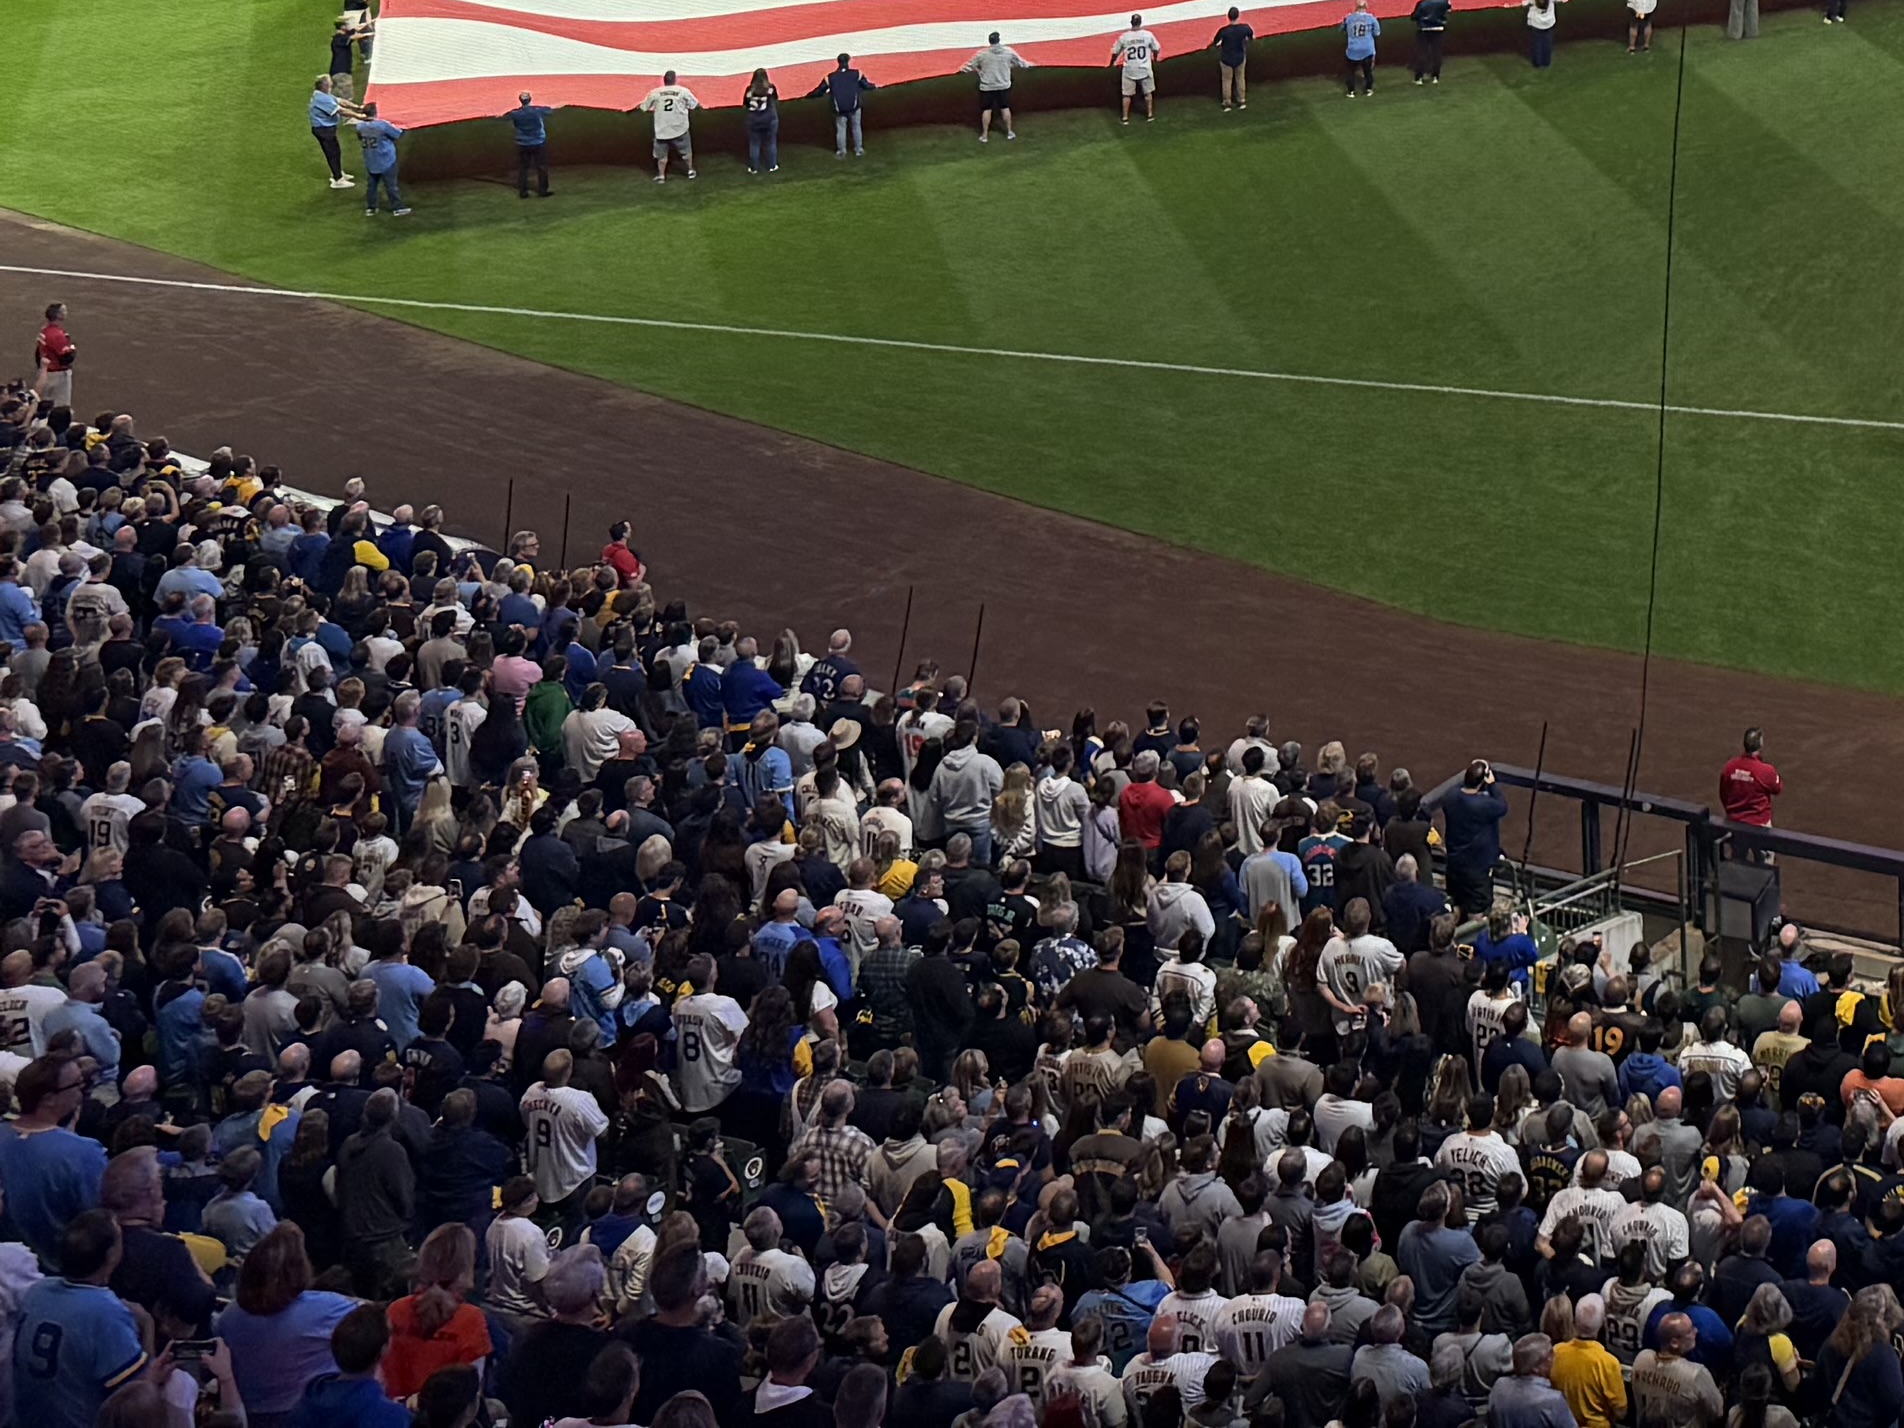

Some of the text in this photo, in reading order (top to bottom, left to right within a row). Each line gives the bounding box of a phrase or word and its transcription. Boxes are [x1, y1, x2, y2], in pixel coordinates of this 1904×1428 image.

[1307, 863, 1334, 887] 32
[683, 1031, 700, 1062] 8
[1593, 1026, 1624, 1056] 19
[537, 1119, 551, 1147] 9
[742, 1283, 759, 1316] 11
[1232, 1307, 1277, 1326] CHOURIO
[1243, 1331, 1266, 1363] 11
